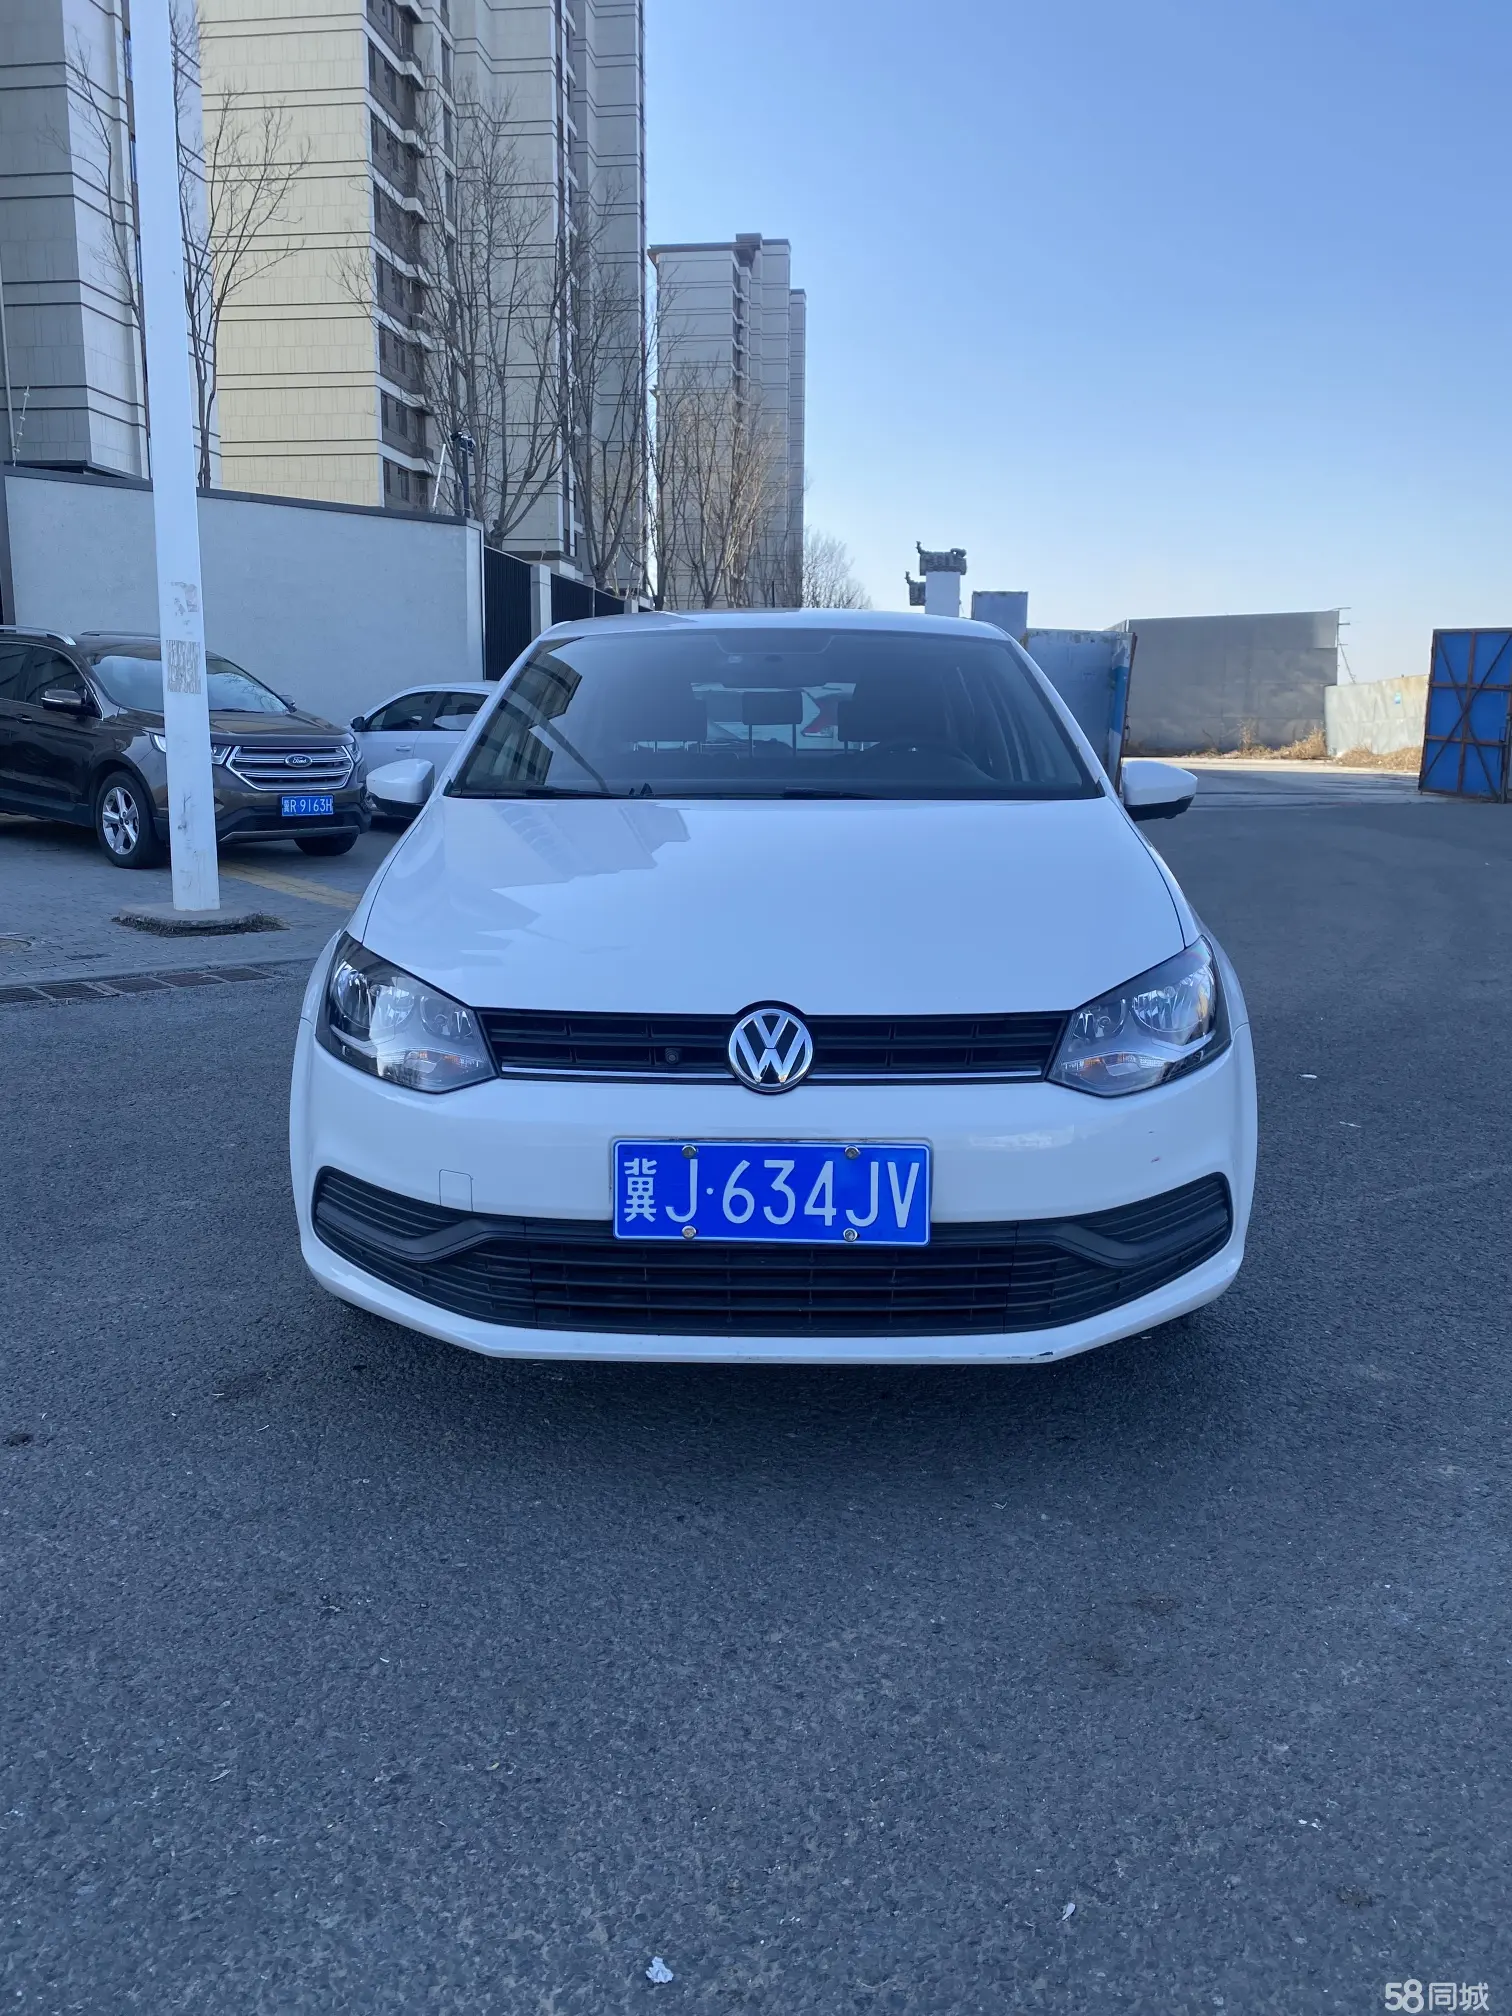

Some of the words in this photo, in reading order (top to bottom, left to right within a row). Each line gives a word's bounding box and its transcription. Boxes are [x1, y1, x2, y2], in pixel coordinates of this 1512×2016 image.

[292, 756, 307, 764] Ford
[733, 1010, 808, 1086] VW
[624, 1158, 920, 1228] 冀J·634JV
